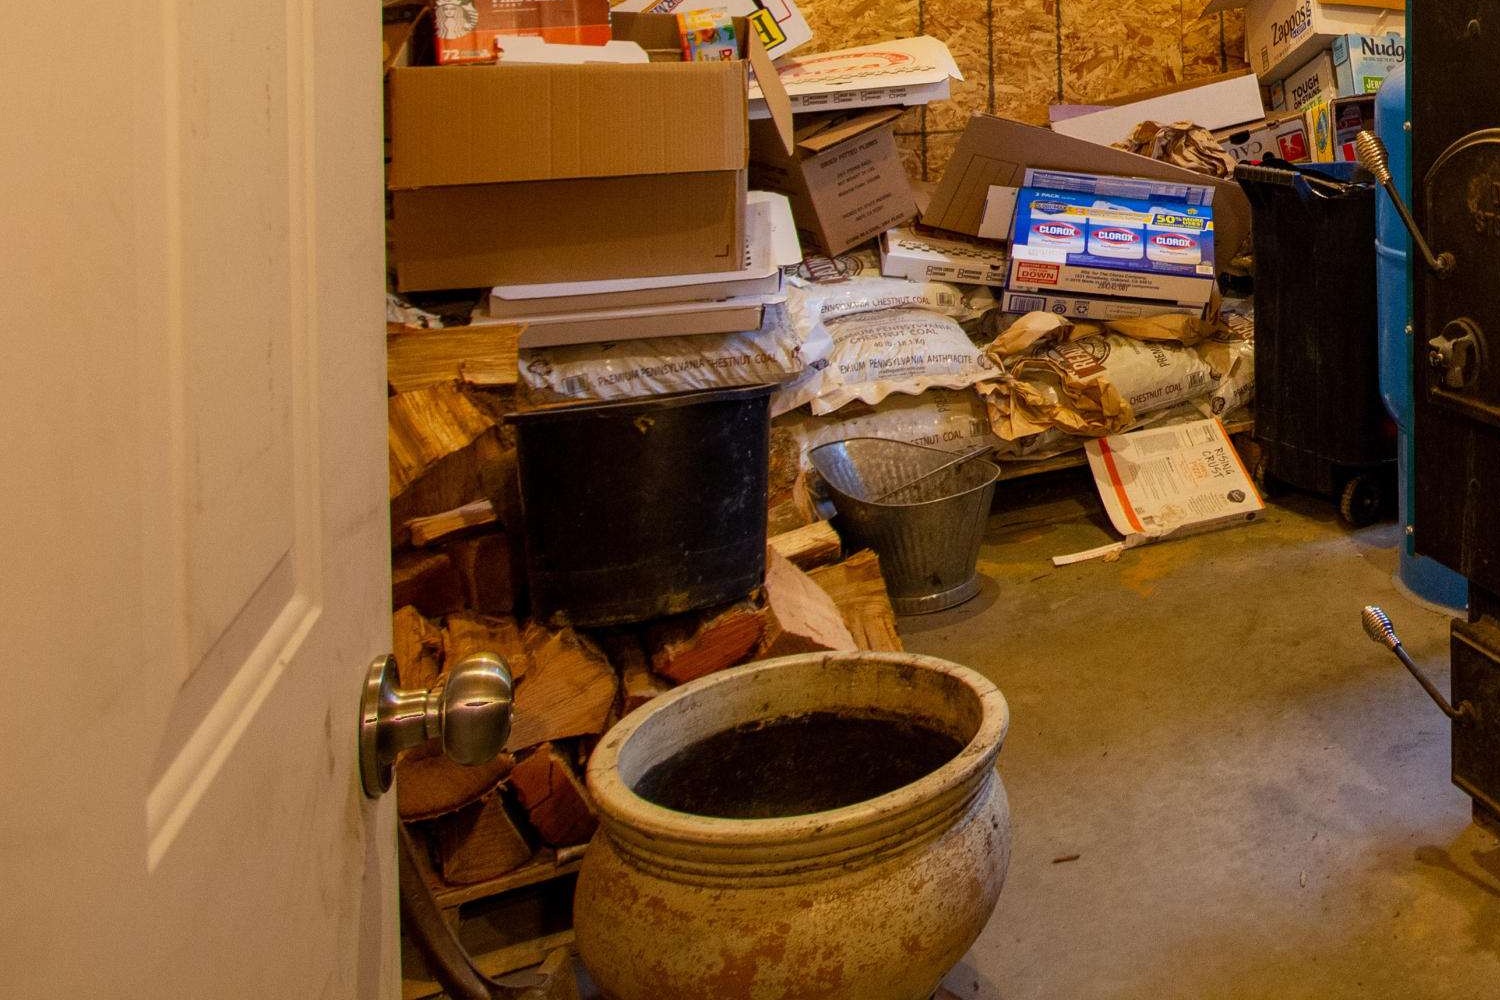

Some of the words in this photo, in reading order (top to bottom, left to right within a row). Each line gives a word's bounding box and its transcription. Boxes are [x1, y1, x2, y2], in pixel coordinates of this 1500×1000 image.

[1271, 5, 1306, 47] Zappos
[442, 49, 460, 61] 72
[1361, 36, 1405, 62] Nudg
[1292, 72, 1320, 101] TOUGH
[1040, 225, 1075, 236] CLOROX
[1098, 231, 1134, 242] CLOROX
[1156, 236, 1191, 247] CLOROX
[1021, 271, 1054, 280] DOWN
[872, 296, 910, 307] CHESTNUT
[912, 296, 931, 305] COAL
[850, 330, 906, 345] CHESTNUT
[910, 328, 938, 336] COAL
[598, 369, 640, 387] PREMIUM
[640, 359, 706, 379] PENNSYLVANIA
[754, 352, 778, 365] COAL
[869, 354, 924, 369] PENNSYLVANIA
[1129, 387, 1163, 405] CHESTNUT
[1165, 382, 1183, 394] COAL
[942, 431, 964, 443] COAL
[1202, 450, 1225, 479] CRUST
[1214, 447, 1235, 476] RISING
